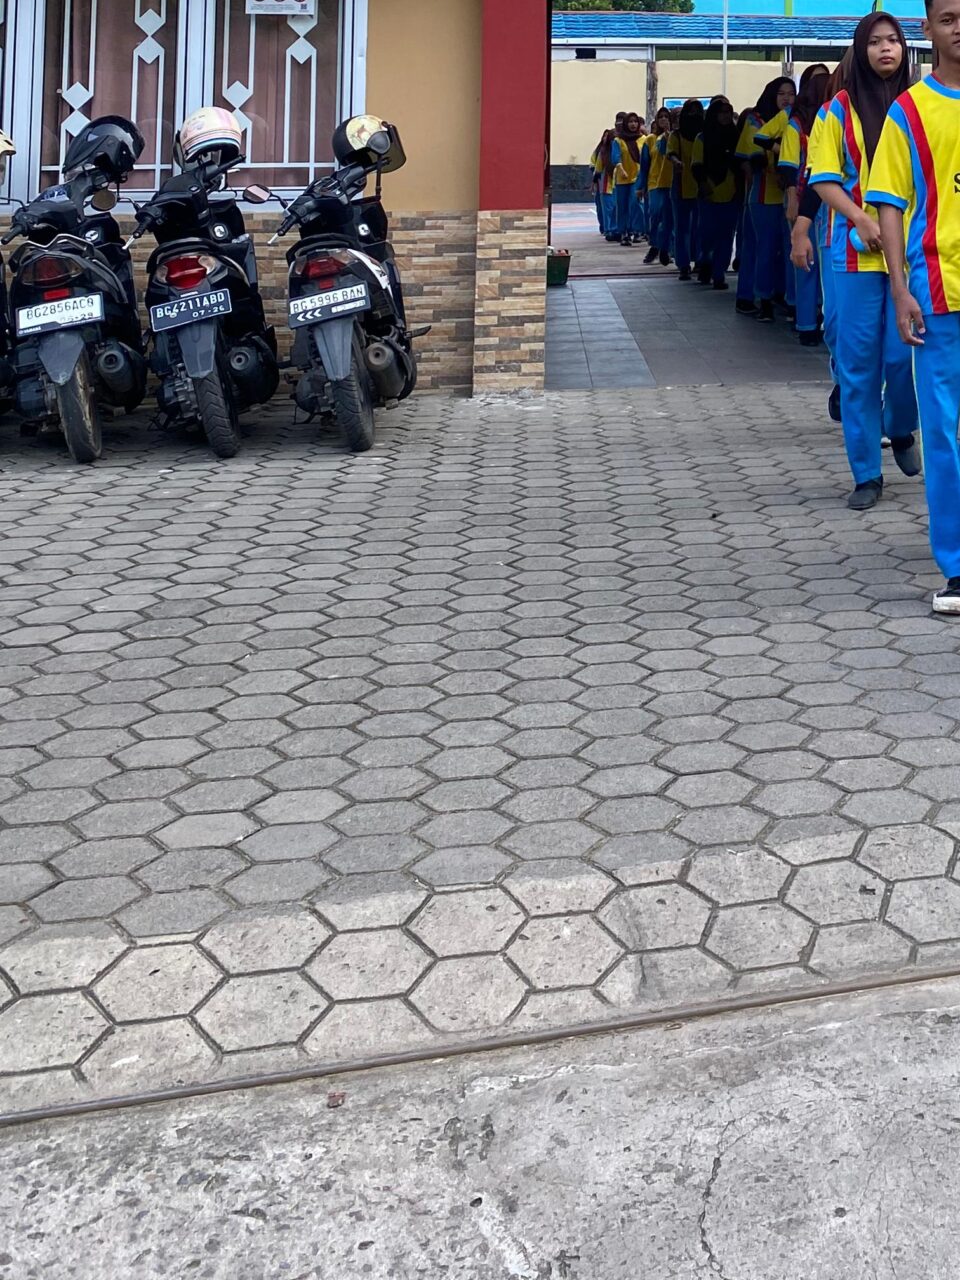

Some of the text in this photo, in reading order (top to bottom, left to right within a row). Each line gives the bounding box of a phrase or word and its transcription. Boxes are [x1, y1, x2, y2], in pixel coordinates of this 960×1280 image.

[293, 301, 308, 313] BG
[310, 293, 339, 307] 5996
[341, 286, 364, 300] BAN
